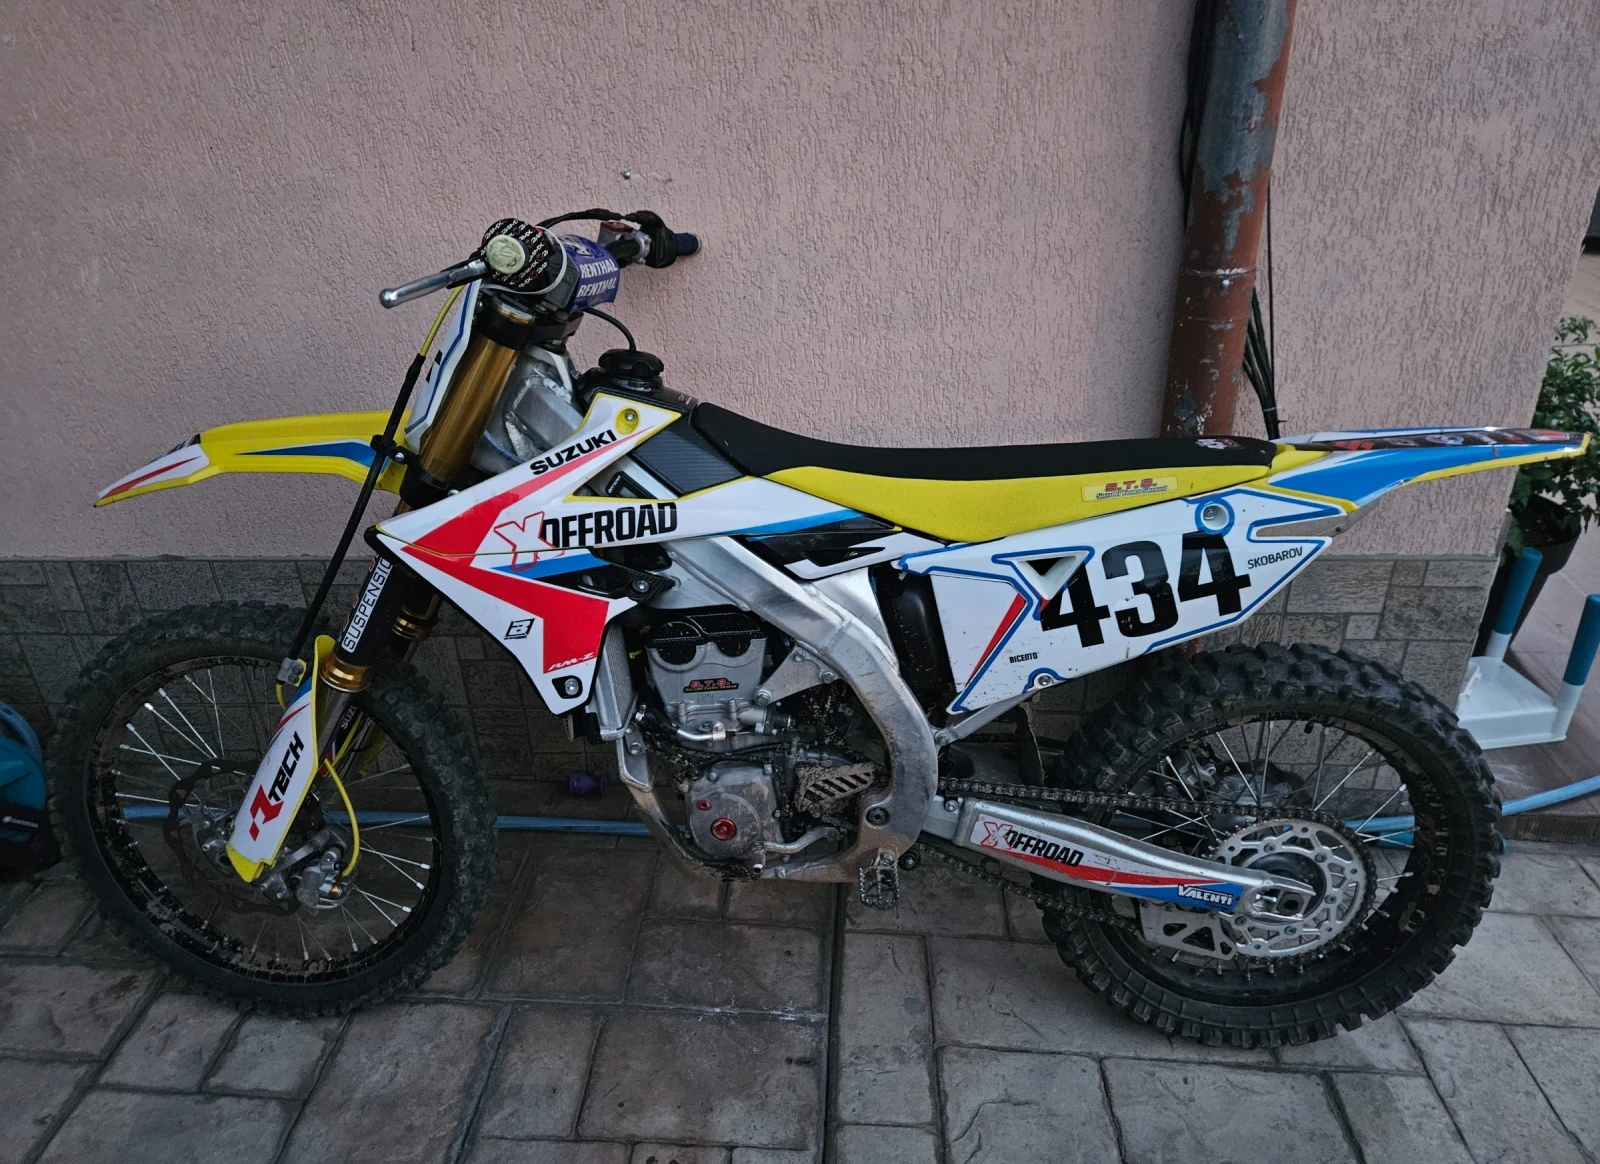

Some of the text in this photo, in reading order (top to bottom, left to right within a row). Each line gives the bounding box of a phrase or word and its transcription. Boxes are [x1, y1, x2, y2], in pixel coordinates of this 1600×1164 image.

[579, 258, 618, 279] RENTHAL
[576, 277, 617, 298] RENTHAL
[530, 429, 617, 475] SUZUKI
[1105, 478, 1157, 492] S.T.S.
[1247, 547, 1303, 570] SKOBAROV
[1039, 530, 1251, 648] 434
[547, 652, 595, 671] RM-Z
[1178, 884, 1233, 906] VALENTI
